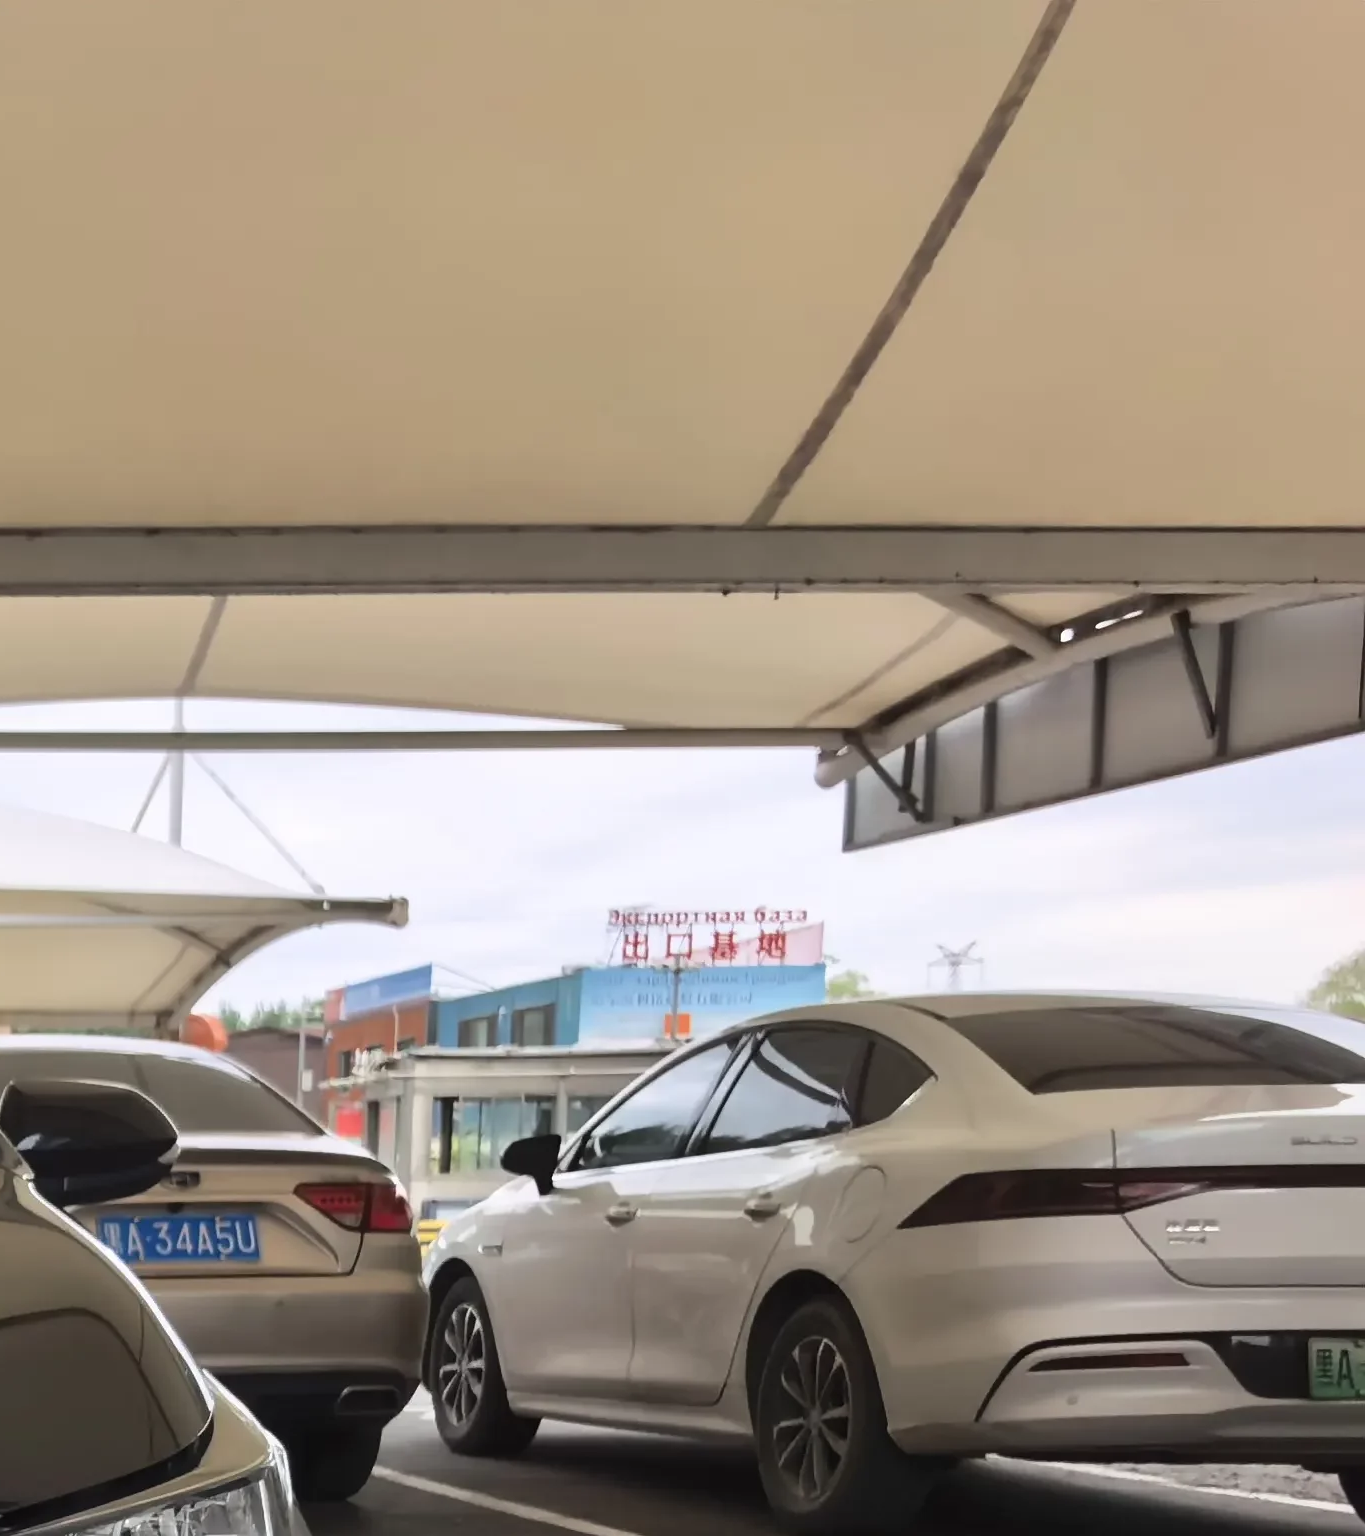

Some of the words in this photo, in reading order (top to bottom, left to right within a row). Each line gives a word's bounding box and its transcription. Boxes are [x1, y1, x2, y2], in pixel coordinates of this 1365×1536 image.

[754, 906, 808, 923] база
[622, 930, 787, 960] 出口基地
